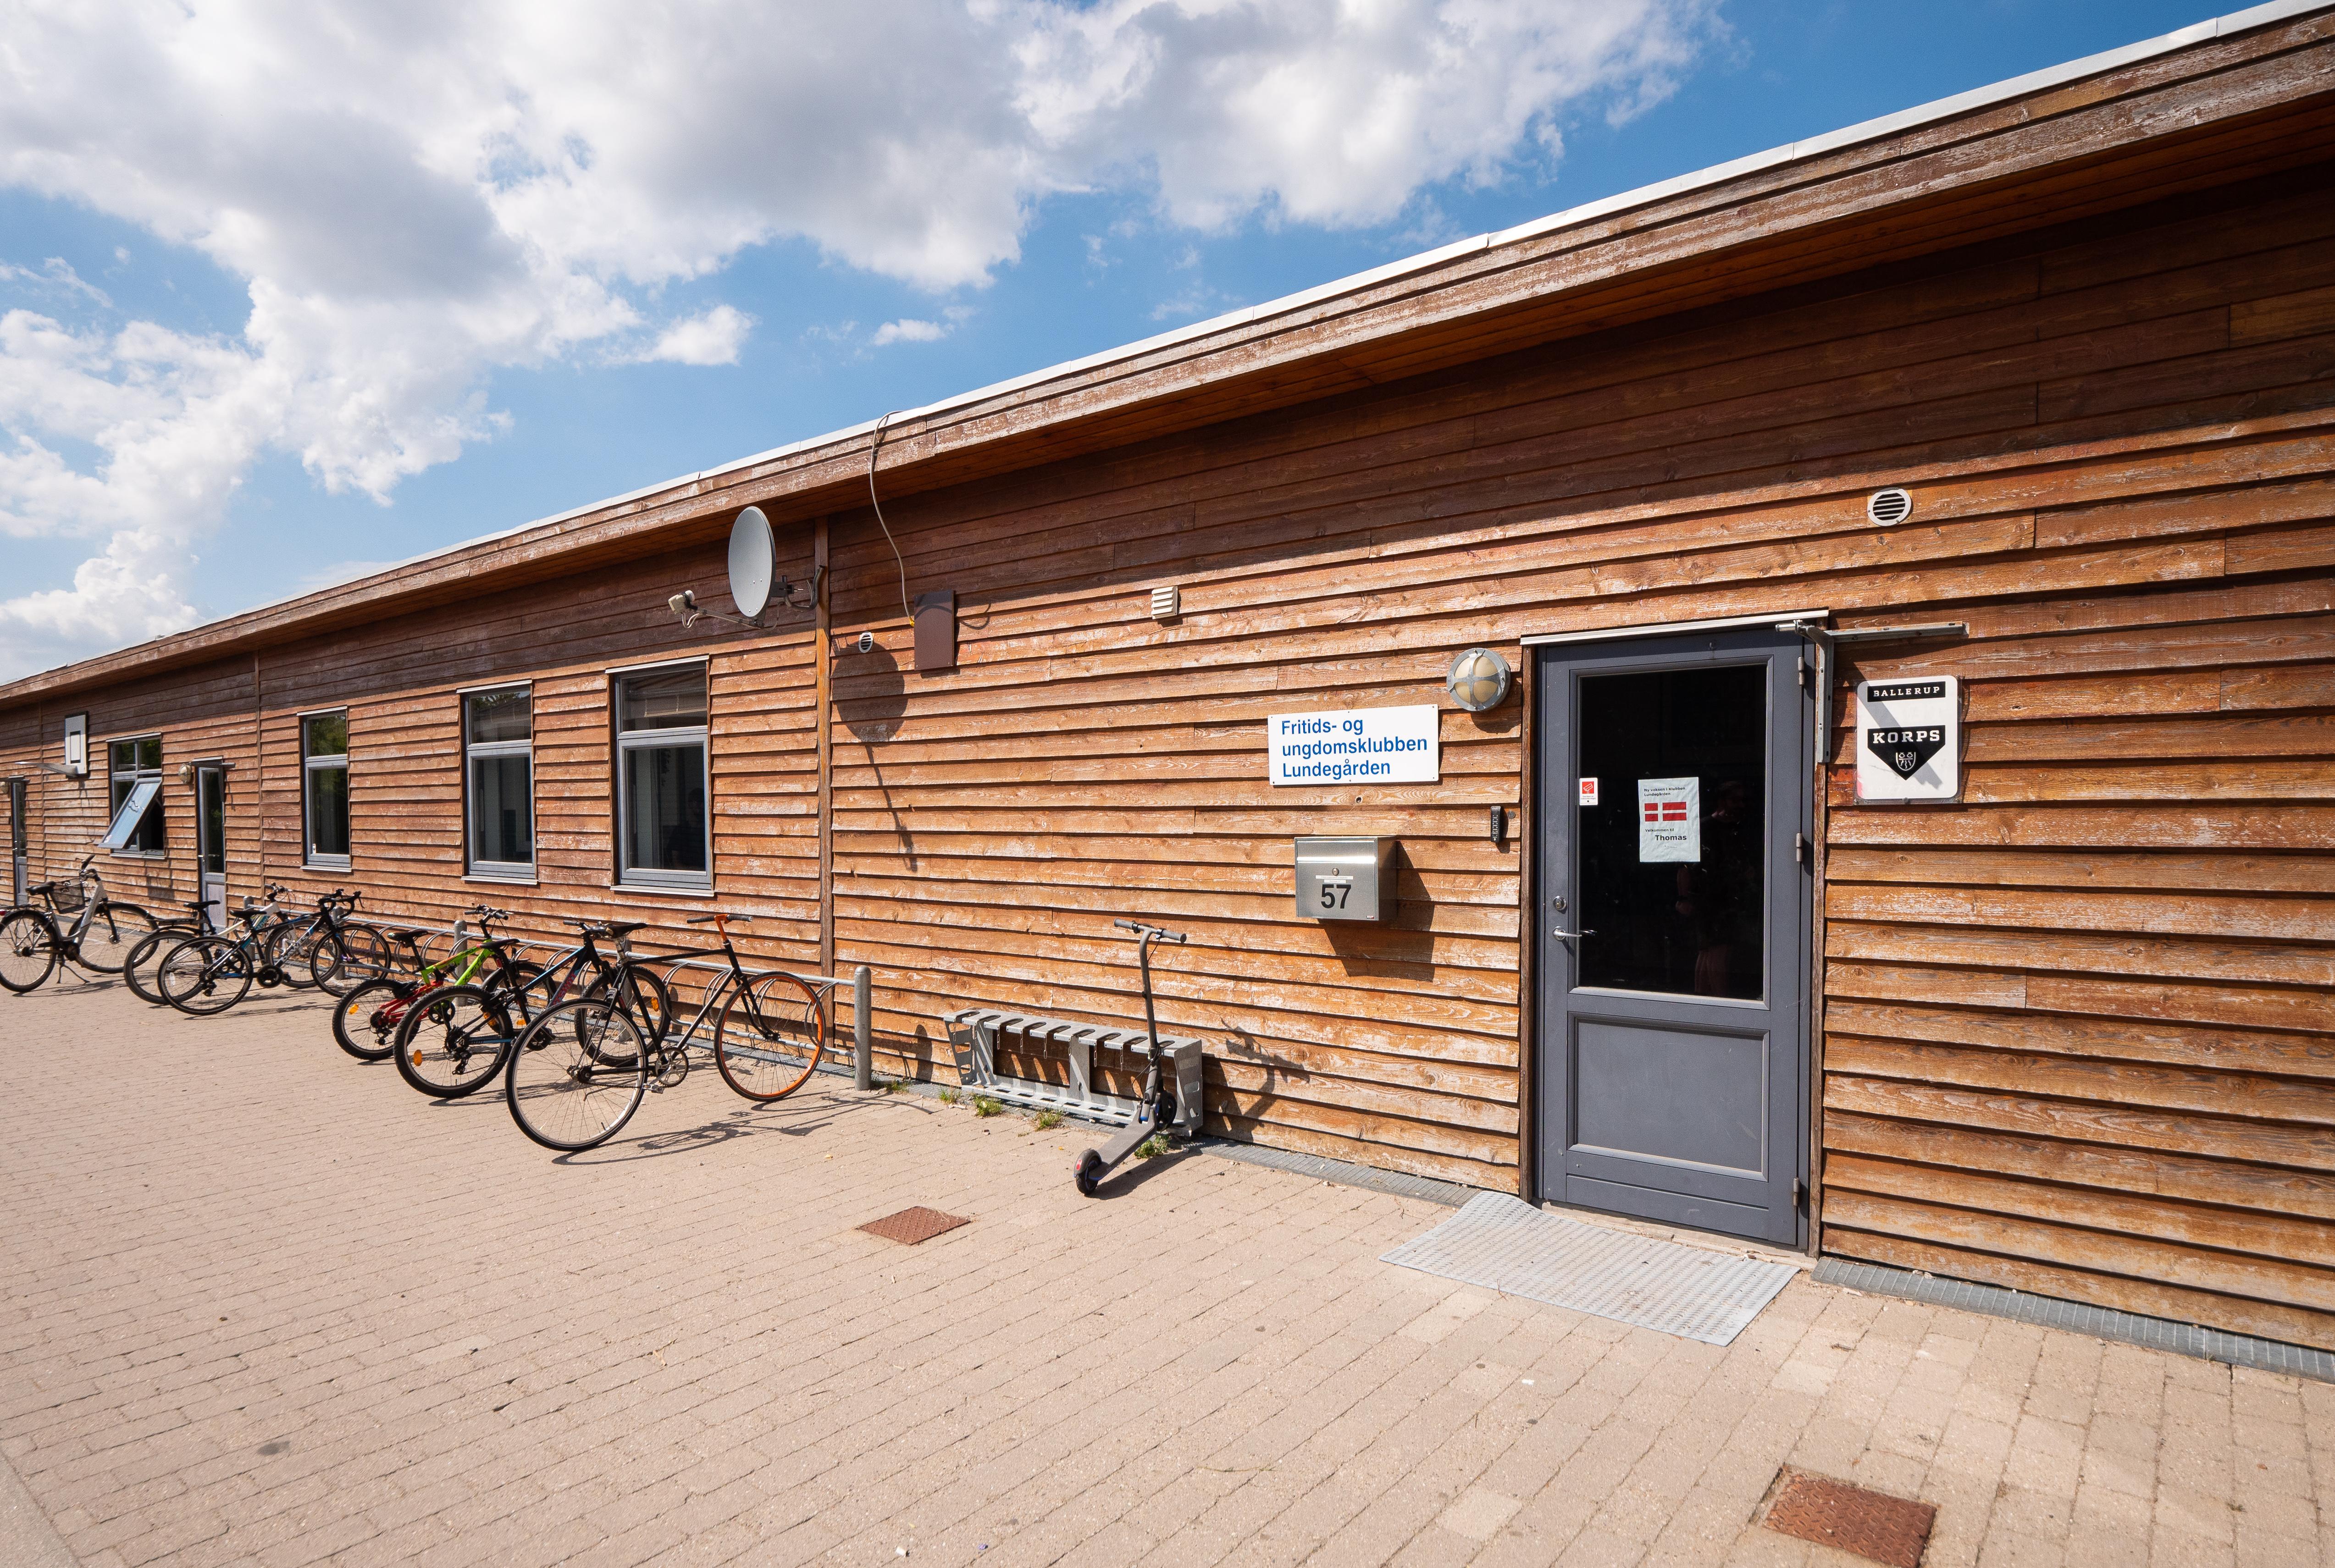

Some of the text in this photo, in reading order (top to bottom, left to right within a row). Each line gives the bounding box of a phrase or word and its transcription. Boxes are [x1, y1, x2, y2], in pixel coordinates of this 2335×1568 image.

[1873, 686, 1940, 697] BALLERUP
[1282, 718, 1363, 735] Fritids- og
[1873, 730, 1940, 744] KORPS
[1282, 736, 1427, 759] ungdomsklubben
[1283, 759, 1390, 780] Lundegården
[1321, 884, 1351, 909] 57
